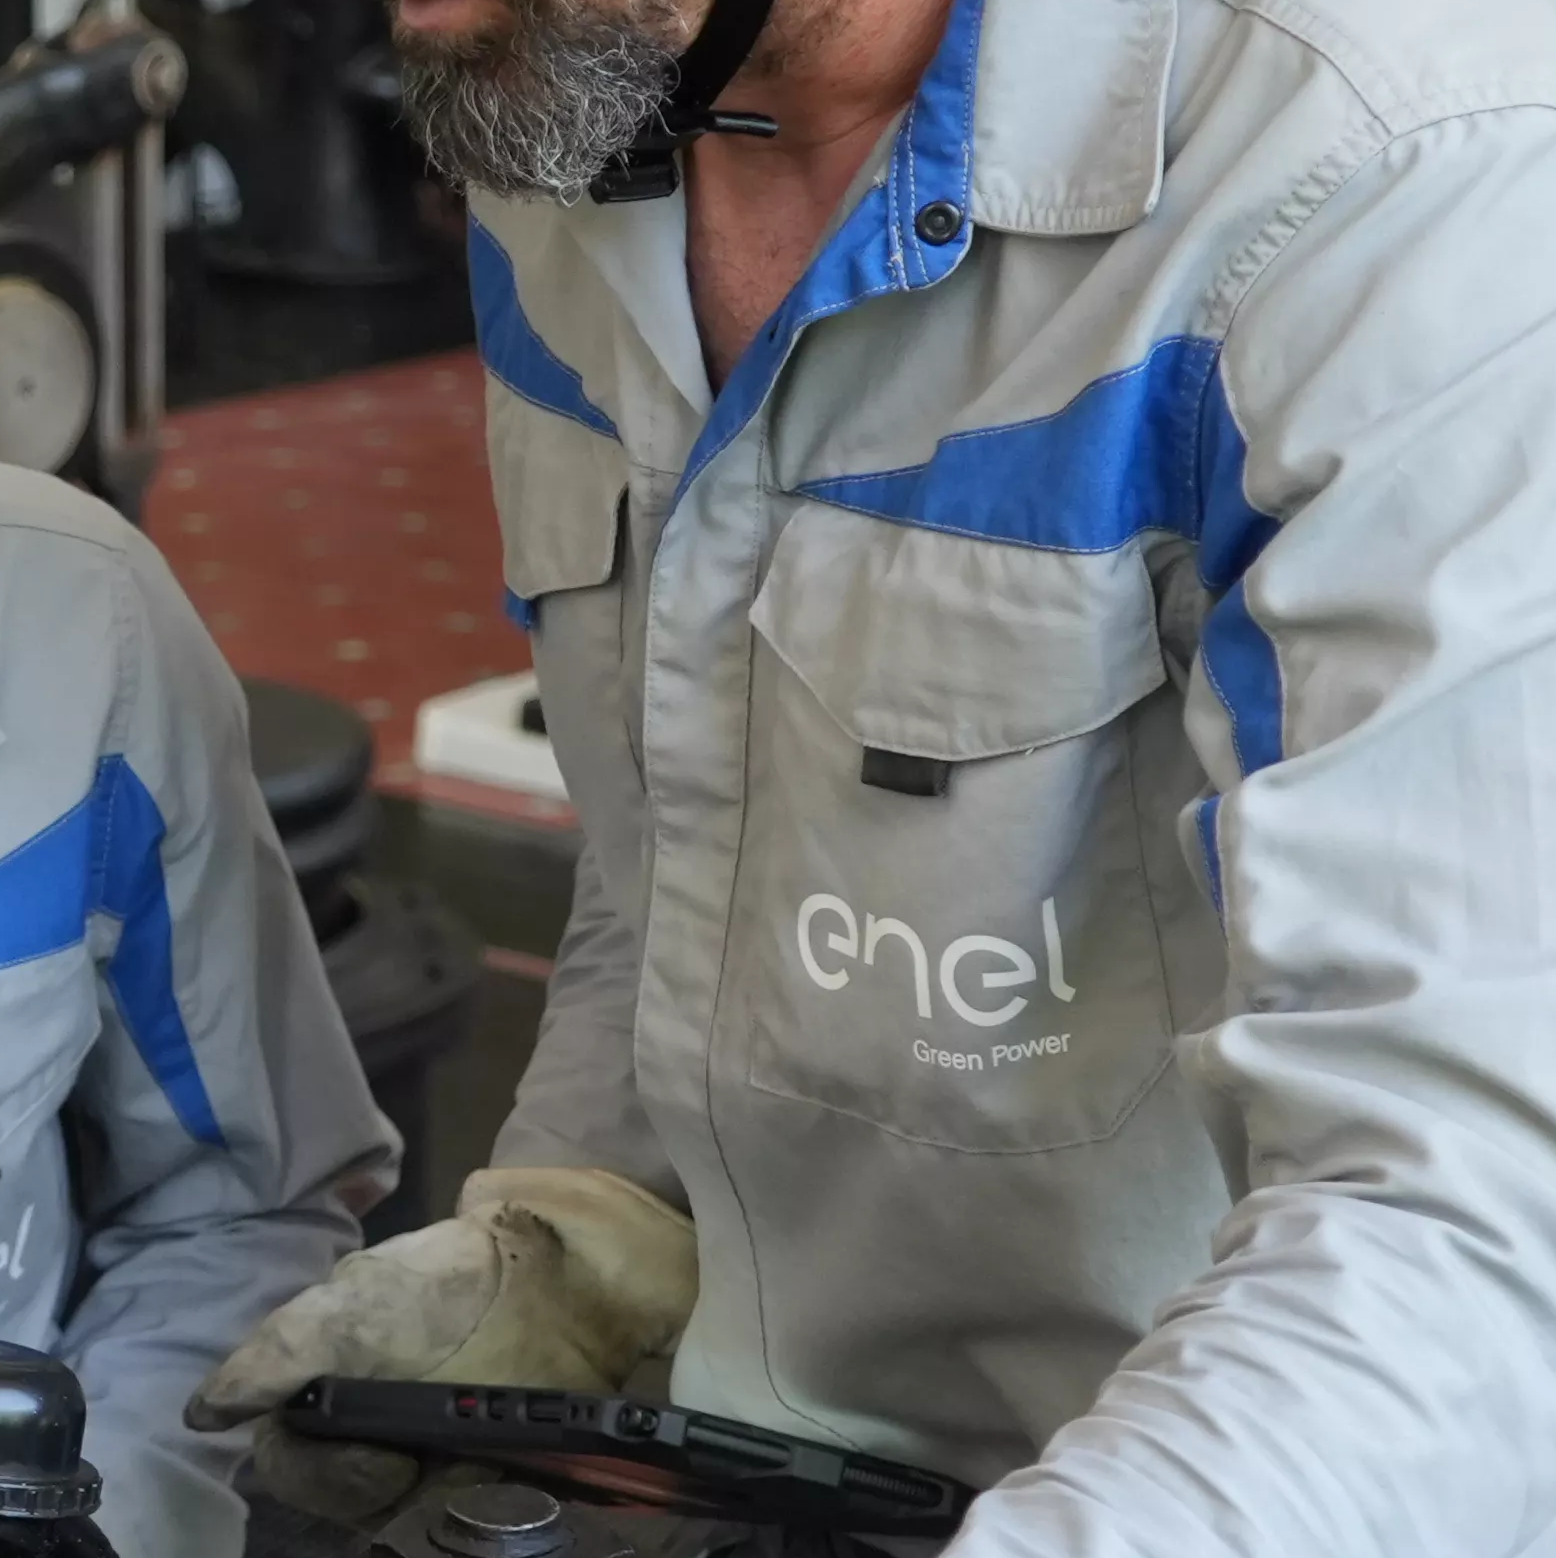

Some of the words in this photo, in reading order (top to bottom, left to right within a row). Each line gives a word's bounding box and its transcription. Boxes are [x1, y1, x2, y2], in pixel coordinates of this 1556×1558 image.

[797, 892, 1076, 1027] enel
[912, 1038, 984, 1071] Green
[991, 1032, 1072, 1067] Power
